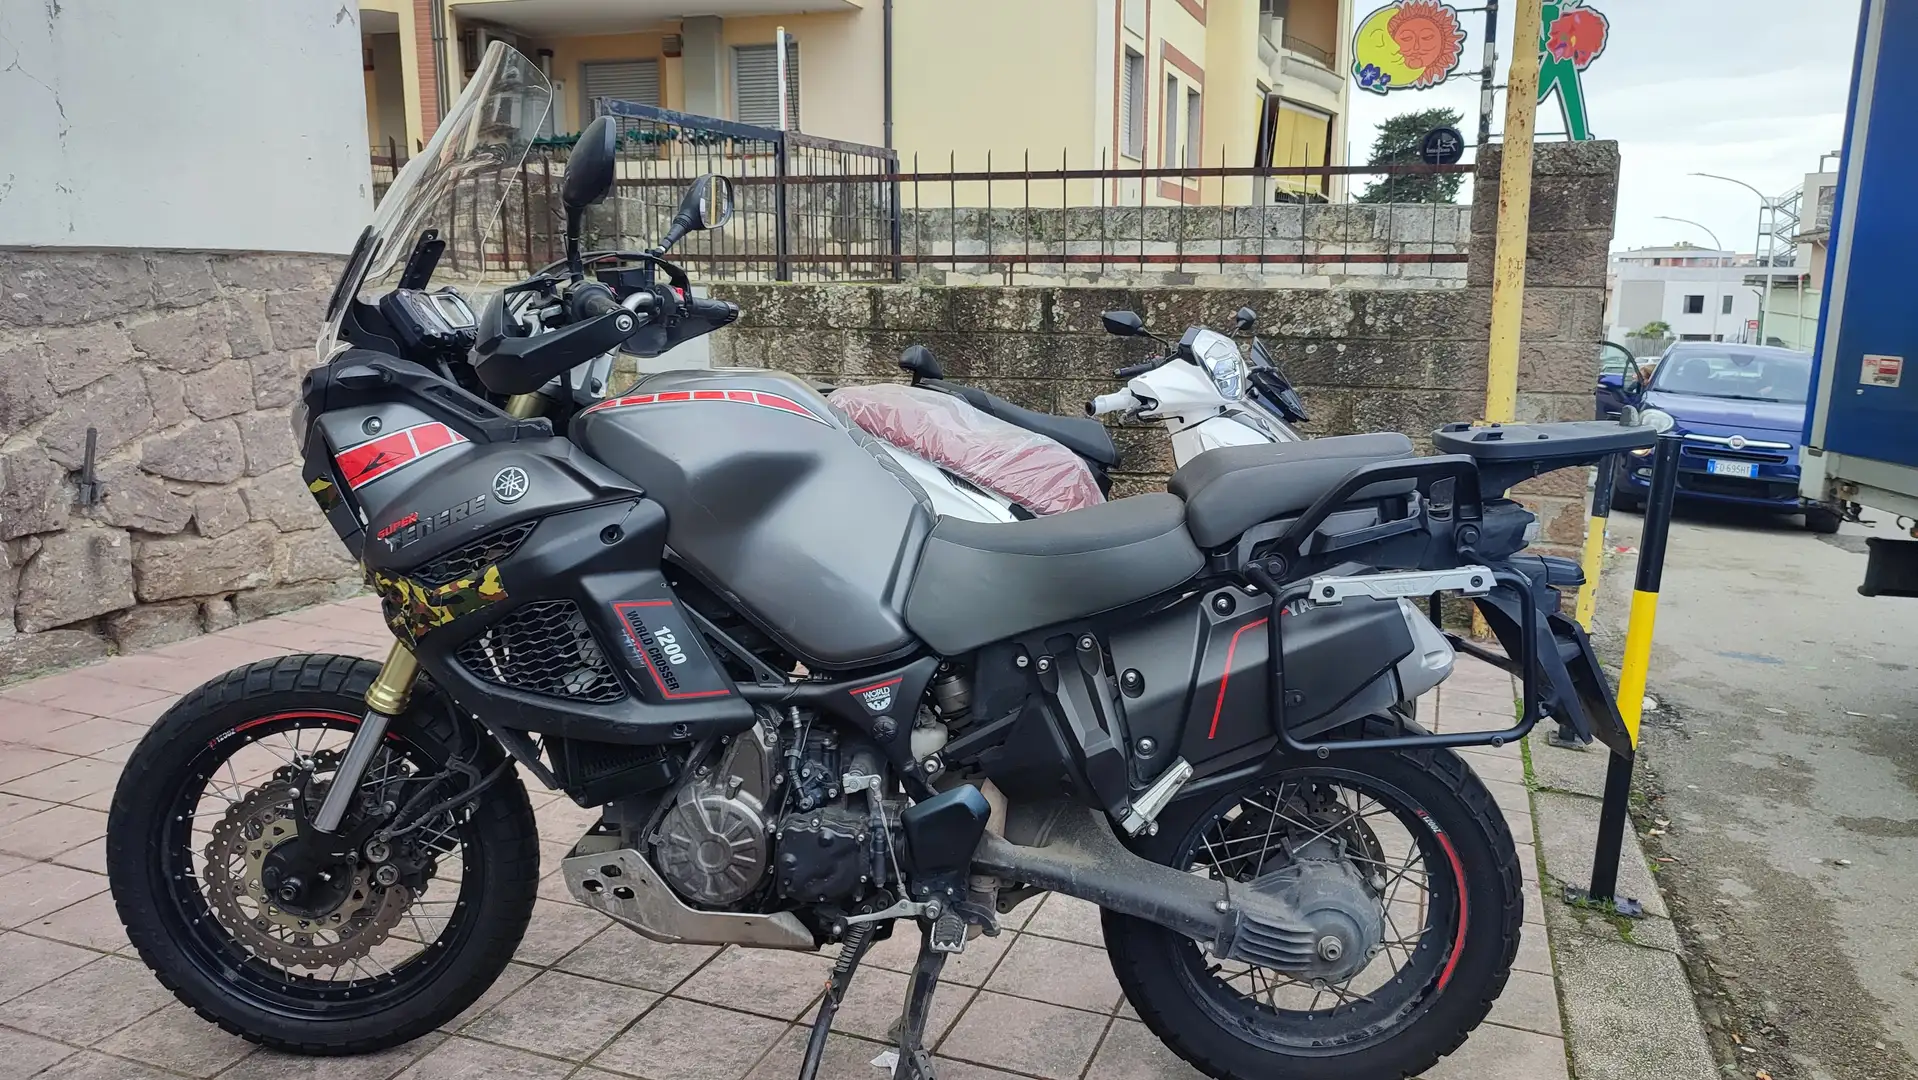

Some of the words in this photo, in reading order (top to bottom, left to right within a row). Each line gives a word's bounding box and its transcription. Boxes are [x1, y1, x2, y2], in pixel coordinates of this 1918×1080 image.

[377, 512, 418, 540] SUPER
[626, 610, 654, 646] WORLD
[648, 647, 680, 691] CROSSER
[653, 626, 687, 665] 1200
[862, 686, 890, 700] WORLD
